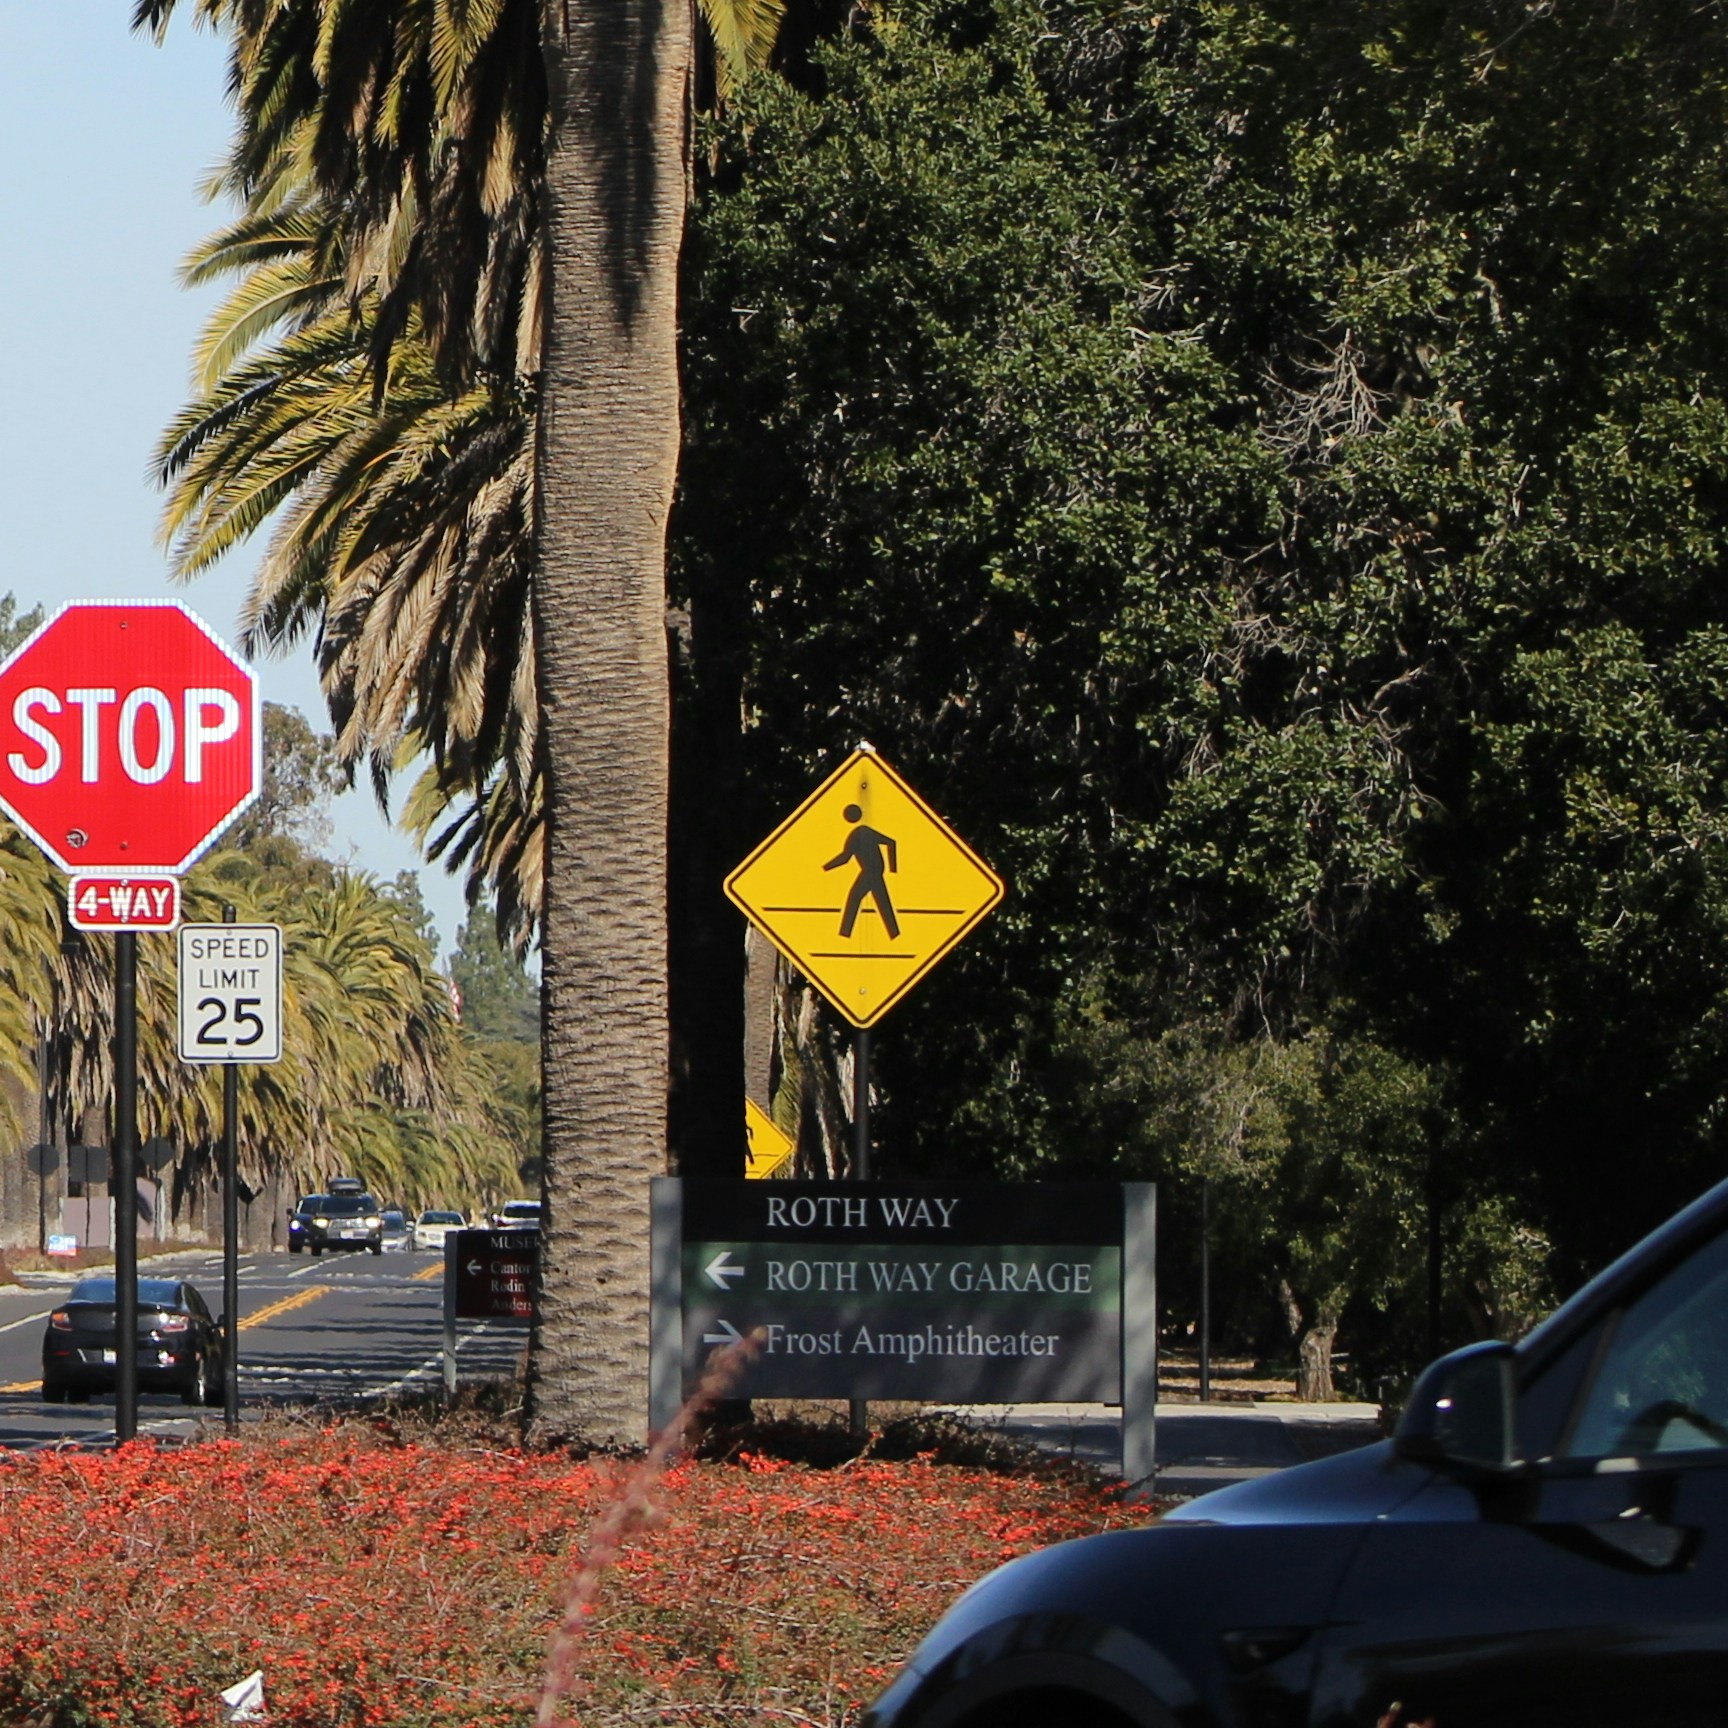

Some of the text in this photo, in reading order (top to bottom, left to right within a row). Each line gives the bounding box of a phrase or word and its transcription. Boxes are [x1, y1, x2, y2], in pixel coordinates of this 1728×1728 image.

[7, 687, 240, 784] STOP
[76, 886, 171, 917] 4-WAY
[191, 938, 269, 959] SPEED
[199, 969, 260, 989] LIMIT
[196, 997, 264, 1046] 25
[766, 1197, 959, 1227] ROTH WAY
[490, 1260, 531, 1274] Cantor
[766, 1260, 1093, 1293] ROTH WAY GARAGE
[491, 1278, 525, 1293] Rodin
[766, 1325, 1060, 1363] Frost Amphitheater
